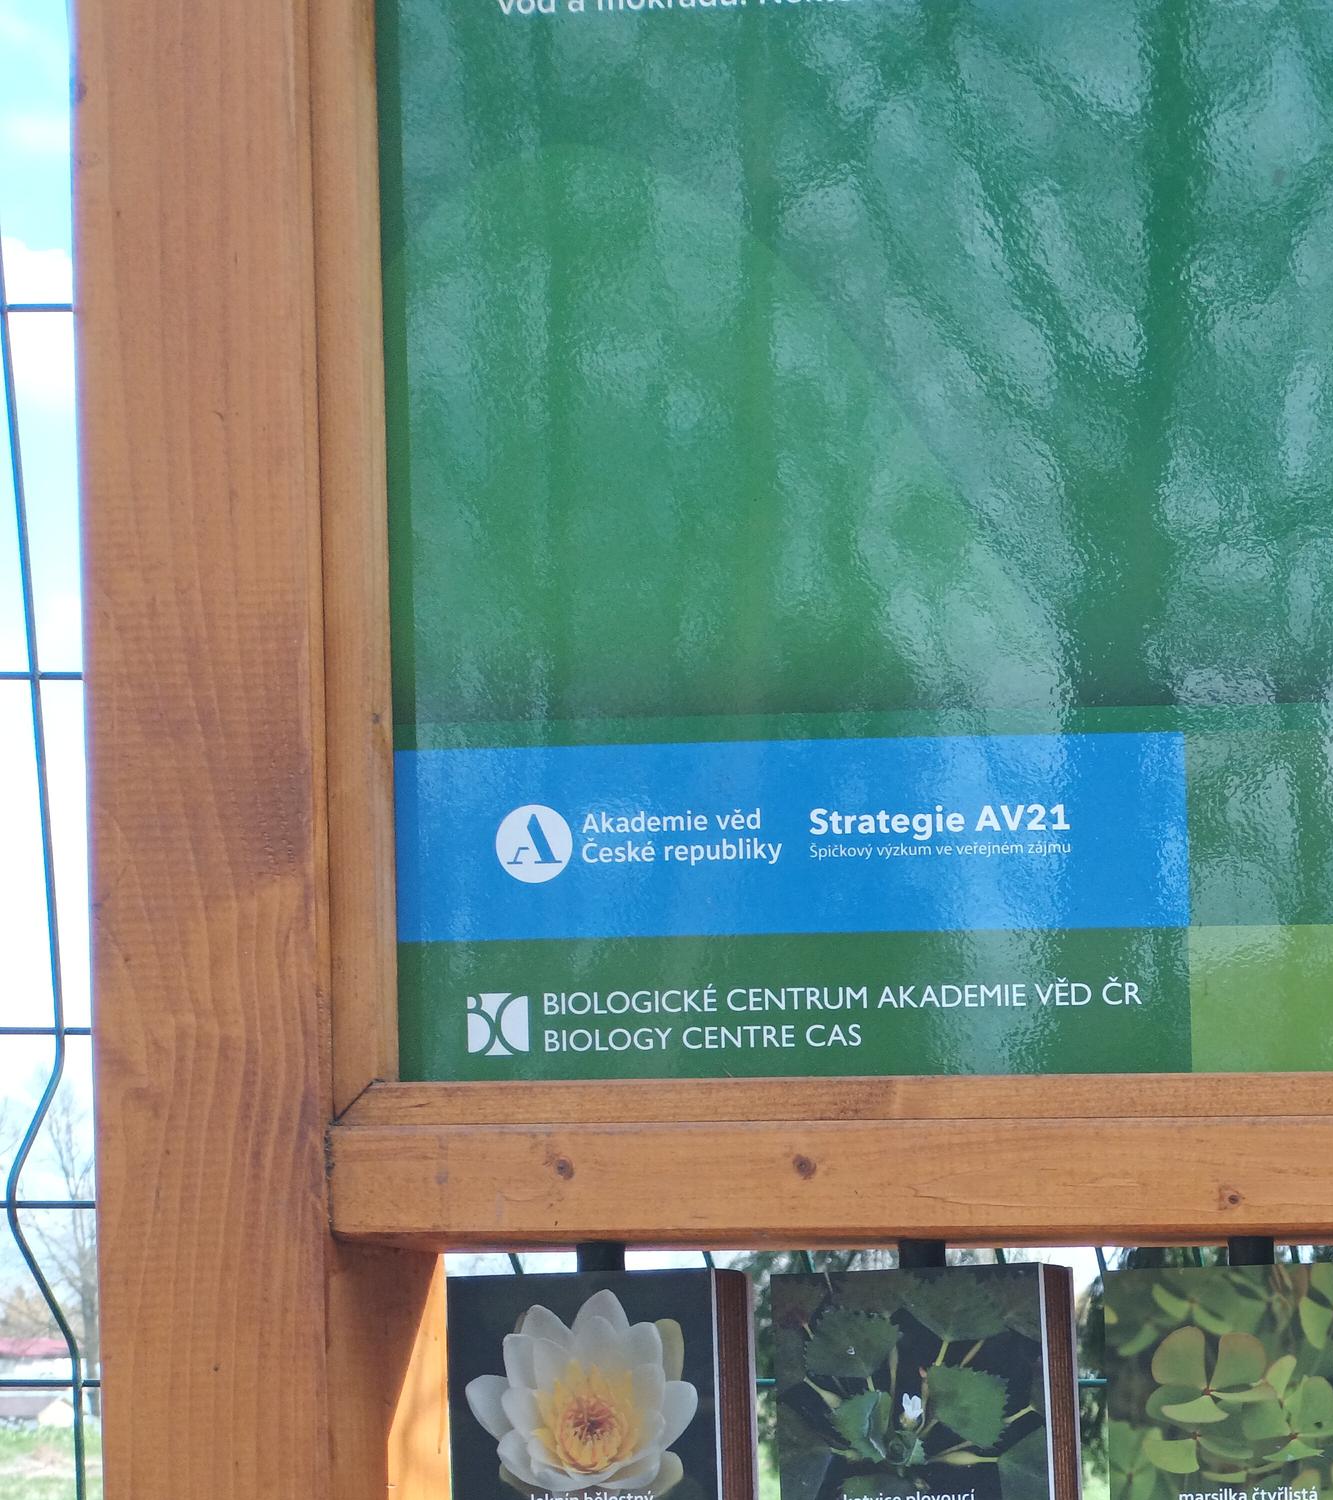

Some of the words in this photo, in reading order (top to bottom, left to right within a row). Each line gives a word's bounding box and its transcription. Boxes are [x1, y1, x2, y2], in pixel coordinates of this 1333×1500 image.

[582, 810, 708, 833] Akademie
[716, 808, 760, 830] věd
[809, 805, 965, 841] Strategie
[976, 804, 1070, 831] AV21
[582, 835, 655, 864] České
[664, 837, 782, 866] republiky
[810, 843, 872, 860] Špičkový
[877, 843, 931, 859] výzkum
[936, 845, 952, 855] ve
[956, 842, 1022, 857] veřejném
[1028, 841, 1071, 856] zájmu
[543, 983, 717, 1015] BIOLOGICKÉ
[727, 986, 867, 1011] CENTRUM
[878, 984, 1026, 1008] AKADEMIE
[1034, 977, 1091, 1006] VĚD
[1102, 976, 1142, 1005] ČR
[544, 1027, 673, 1052] BIOLOGY
[682, 1025, 795, 1049] CENTRE
[806, 1024, 861, 1047] CAS
